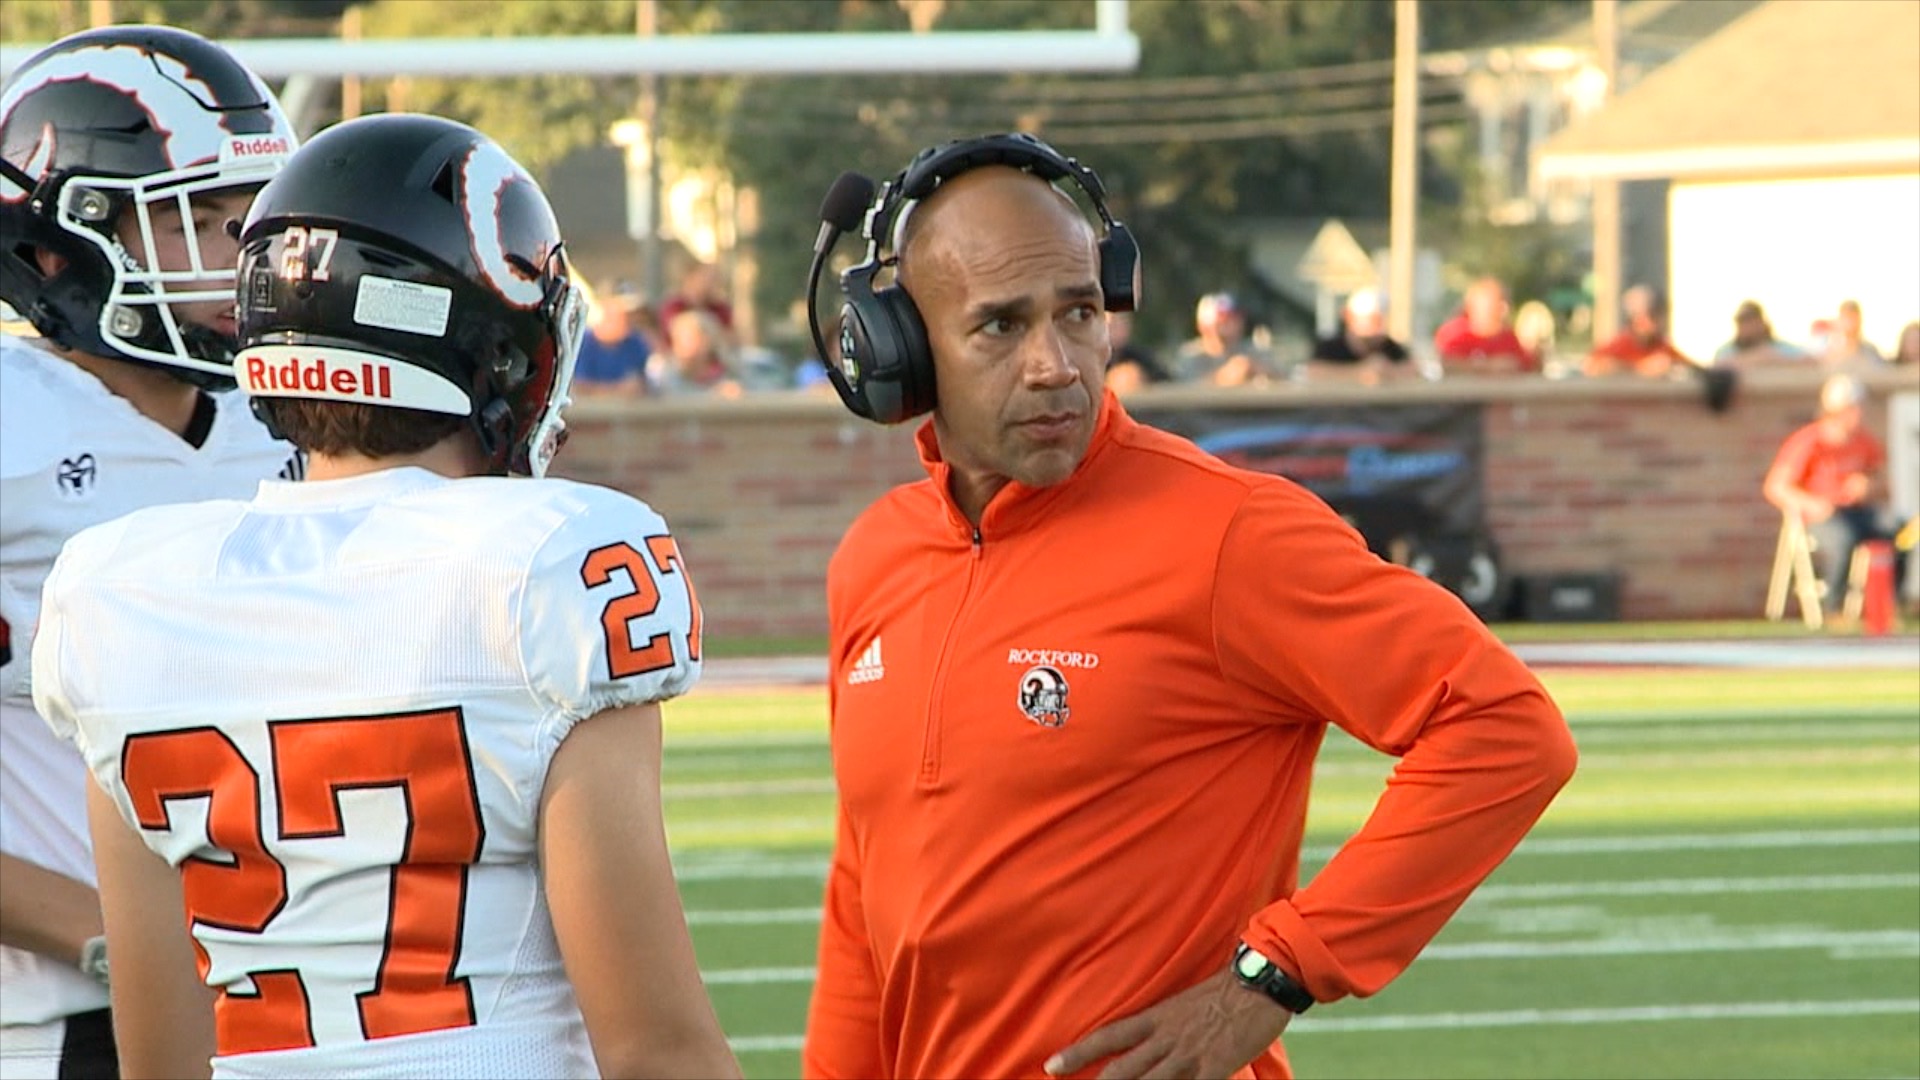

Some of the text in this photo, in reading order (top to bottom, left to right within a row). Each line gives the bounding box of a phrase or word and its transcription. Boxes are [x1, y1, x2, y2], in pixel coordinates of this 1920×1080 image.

[279, 225, 338, 281] 27
[246, 357, 392, 399] Riddell
[1007, 648, 1099, 669] ROCKFORD
[121, 705, 486, 1057] 27
